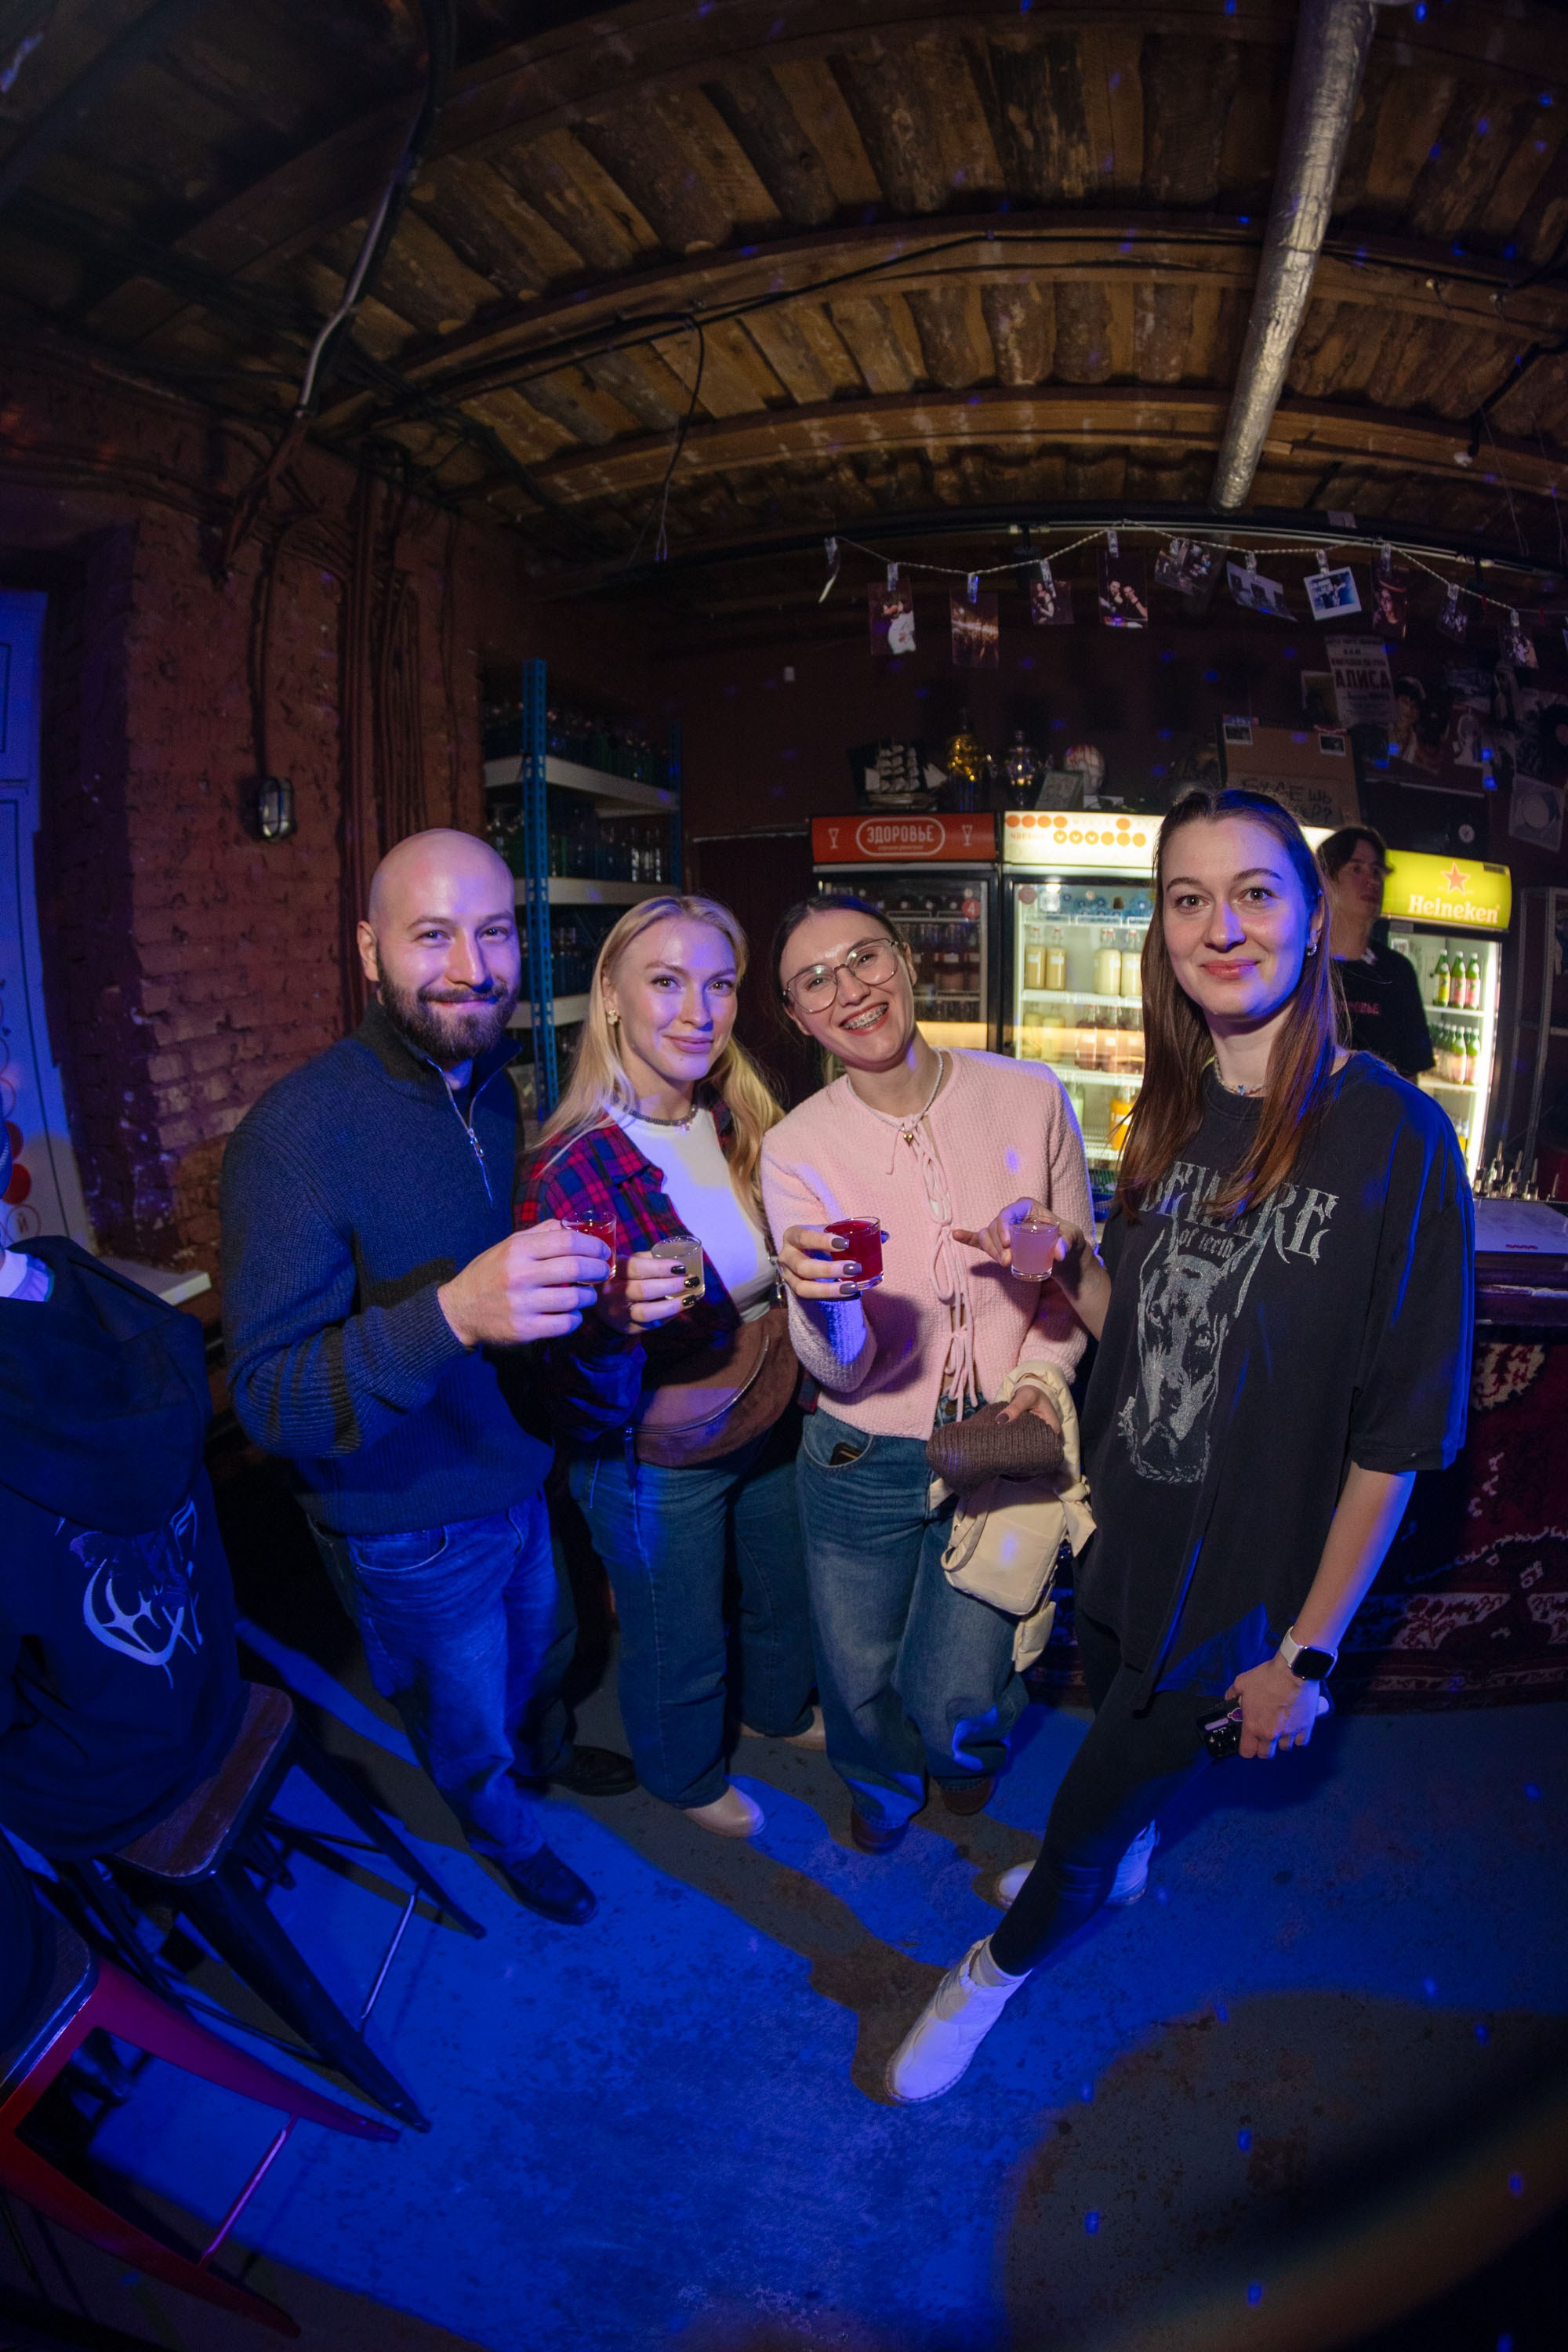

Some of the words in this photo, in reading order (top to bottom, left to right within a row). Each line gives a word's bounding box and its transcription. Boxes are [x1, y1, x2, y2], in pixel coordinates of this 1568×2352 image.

[1335, 668, 1391, 689] АЛИСА
[866, 825, 935, 844] ЗДОРОВЬЕ
[967, 902, 976, 916] 4
[1408, 894, 1498, 924] Heineken
[1178, 1226, 1200, 1248] of
